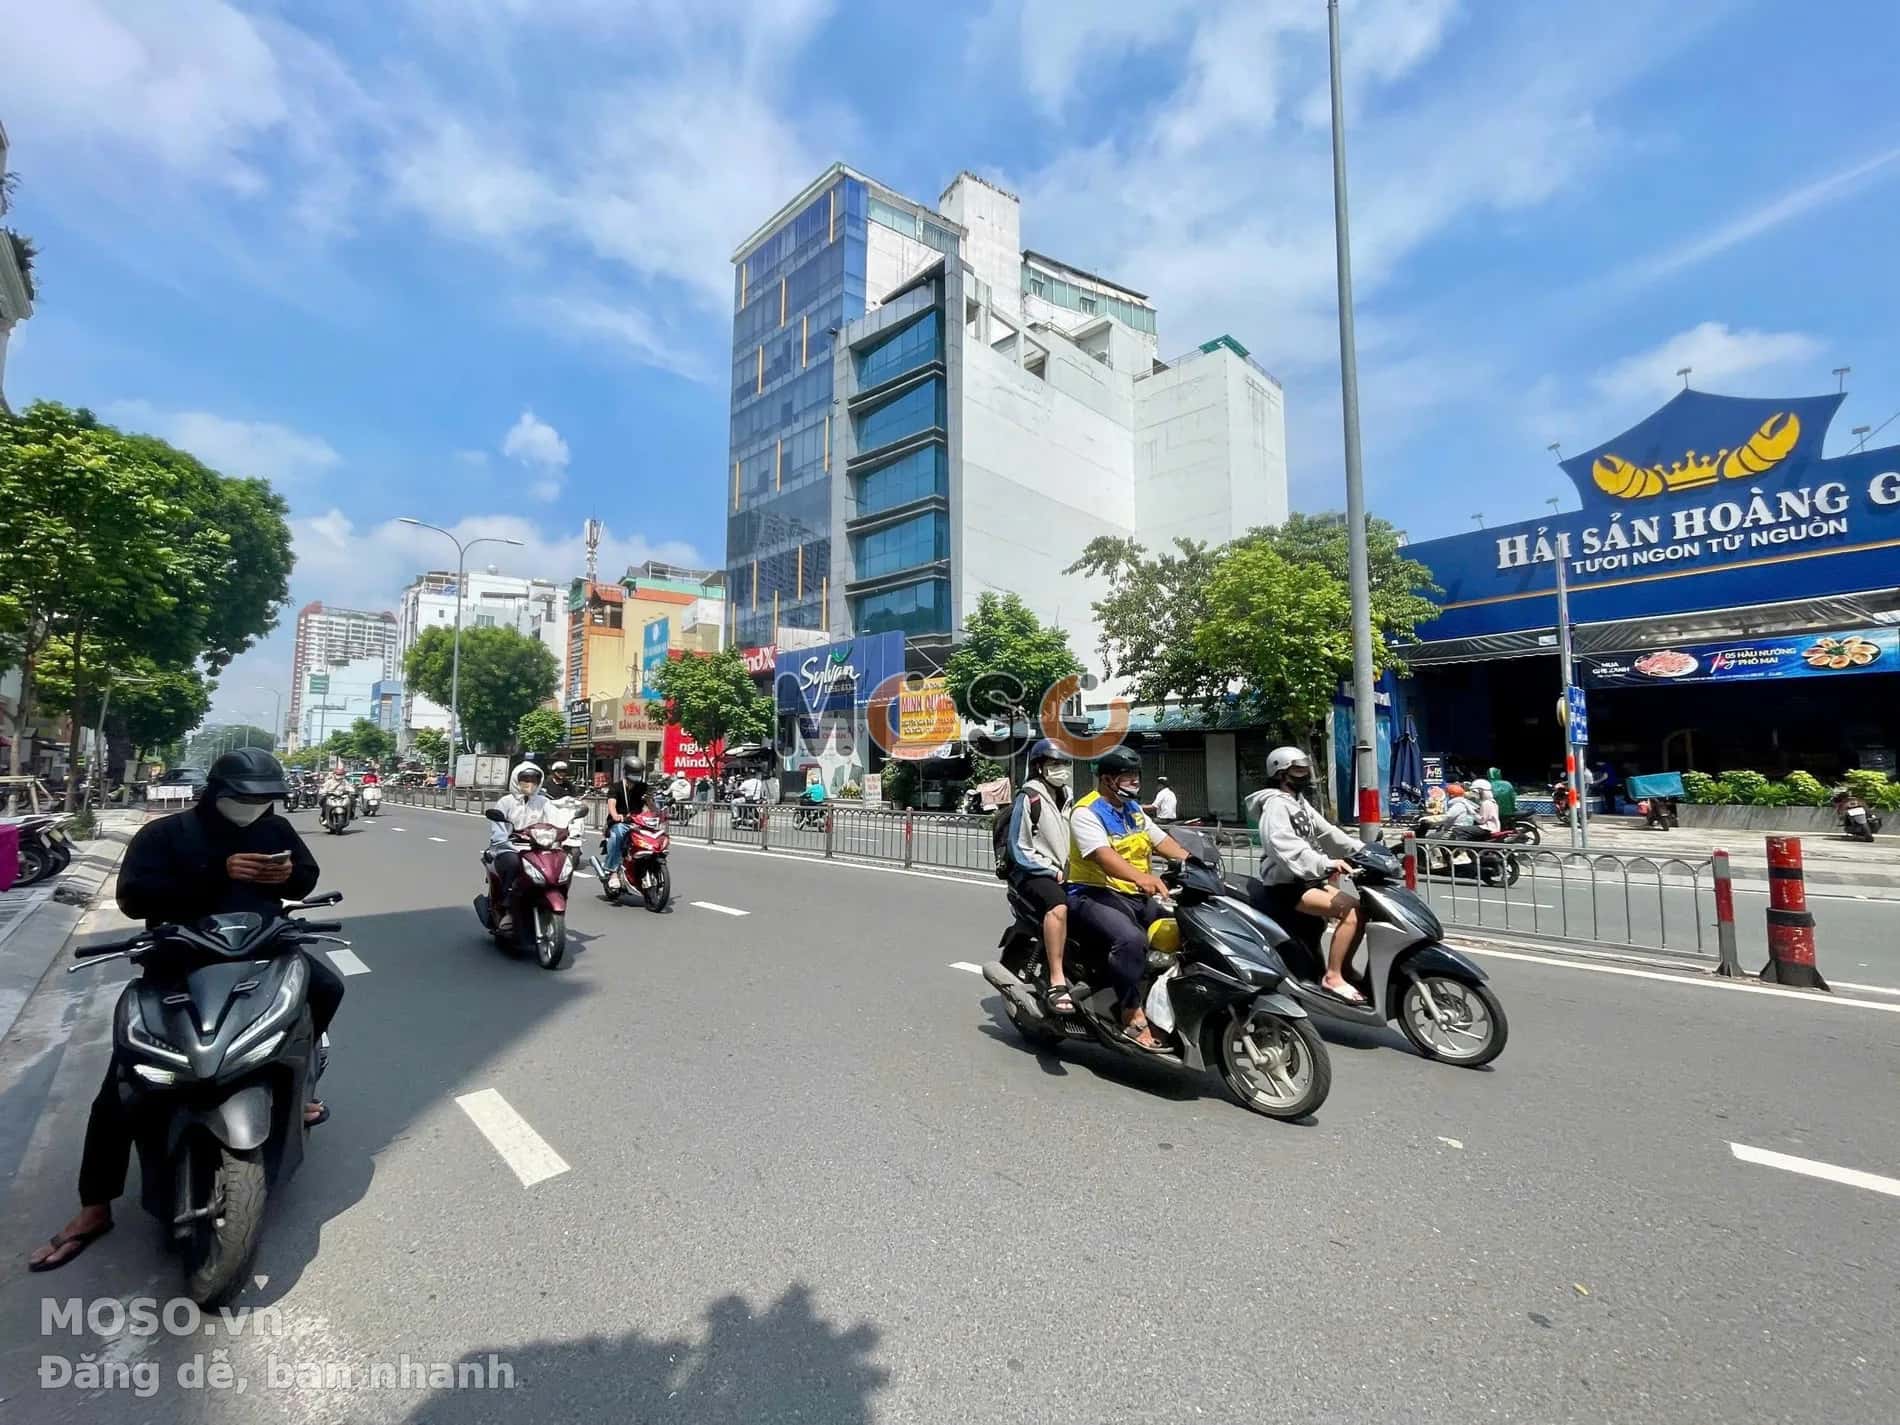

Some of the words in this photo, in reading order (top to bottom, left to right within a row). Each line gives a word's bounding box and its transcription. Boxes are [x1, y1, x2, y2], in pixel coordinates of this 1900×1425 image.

[1496, 526, 1572, 569] HẢI
[1582, 513, 1660, 555] SẢN
[1672, 482, 1850, 540] HOÀNG
[1572, 553, 1629, 575] TƯƠI
[1632, 542, 1700, 566] NGON
[1706, 532, 1744, 554] TỪ
[1750, 517, 1849, 548] NGUỒN
[800, 655, 861, 708] Sylvan
